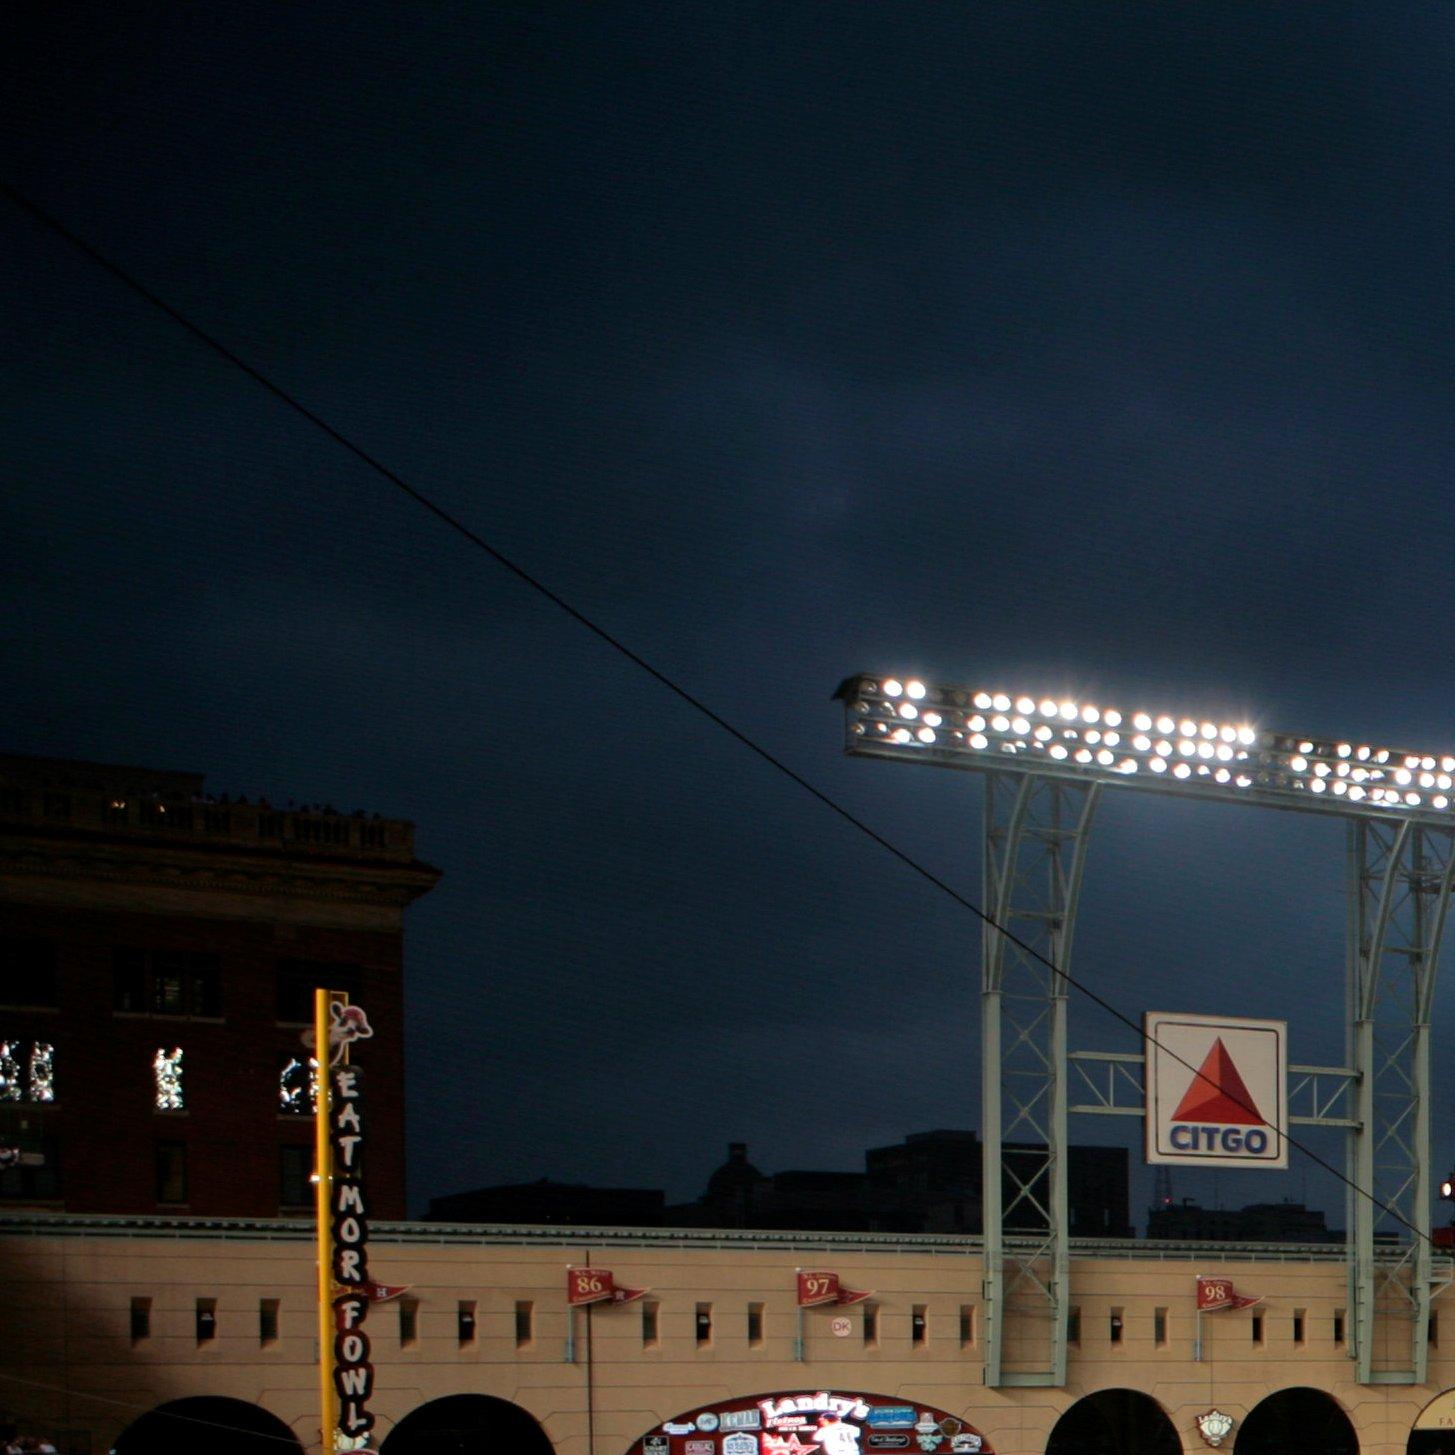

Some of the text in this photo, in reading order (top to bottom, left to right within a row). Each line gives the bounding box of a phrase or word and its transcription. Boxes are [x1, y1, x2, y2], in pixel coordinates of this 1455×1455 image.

[1168, 1124, 1269, 1155] CITGO
[336, 1069, 369, 1430] EAT MOR FOWL
[576, 1276, 601, 1294] 86
[806, 1279, 830, 1295] 97
[1204, 1285, 1226, 1300] 98
[760, 1391, 871, 1421] Landry's
